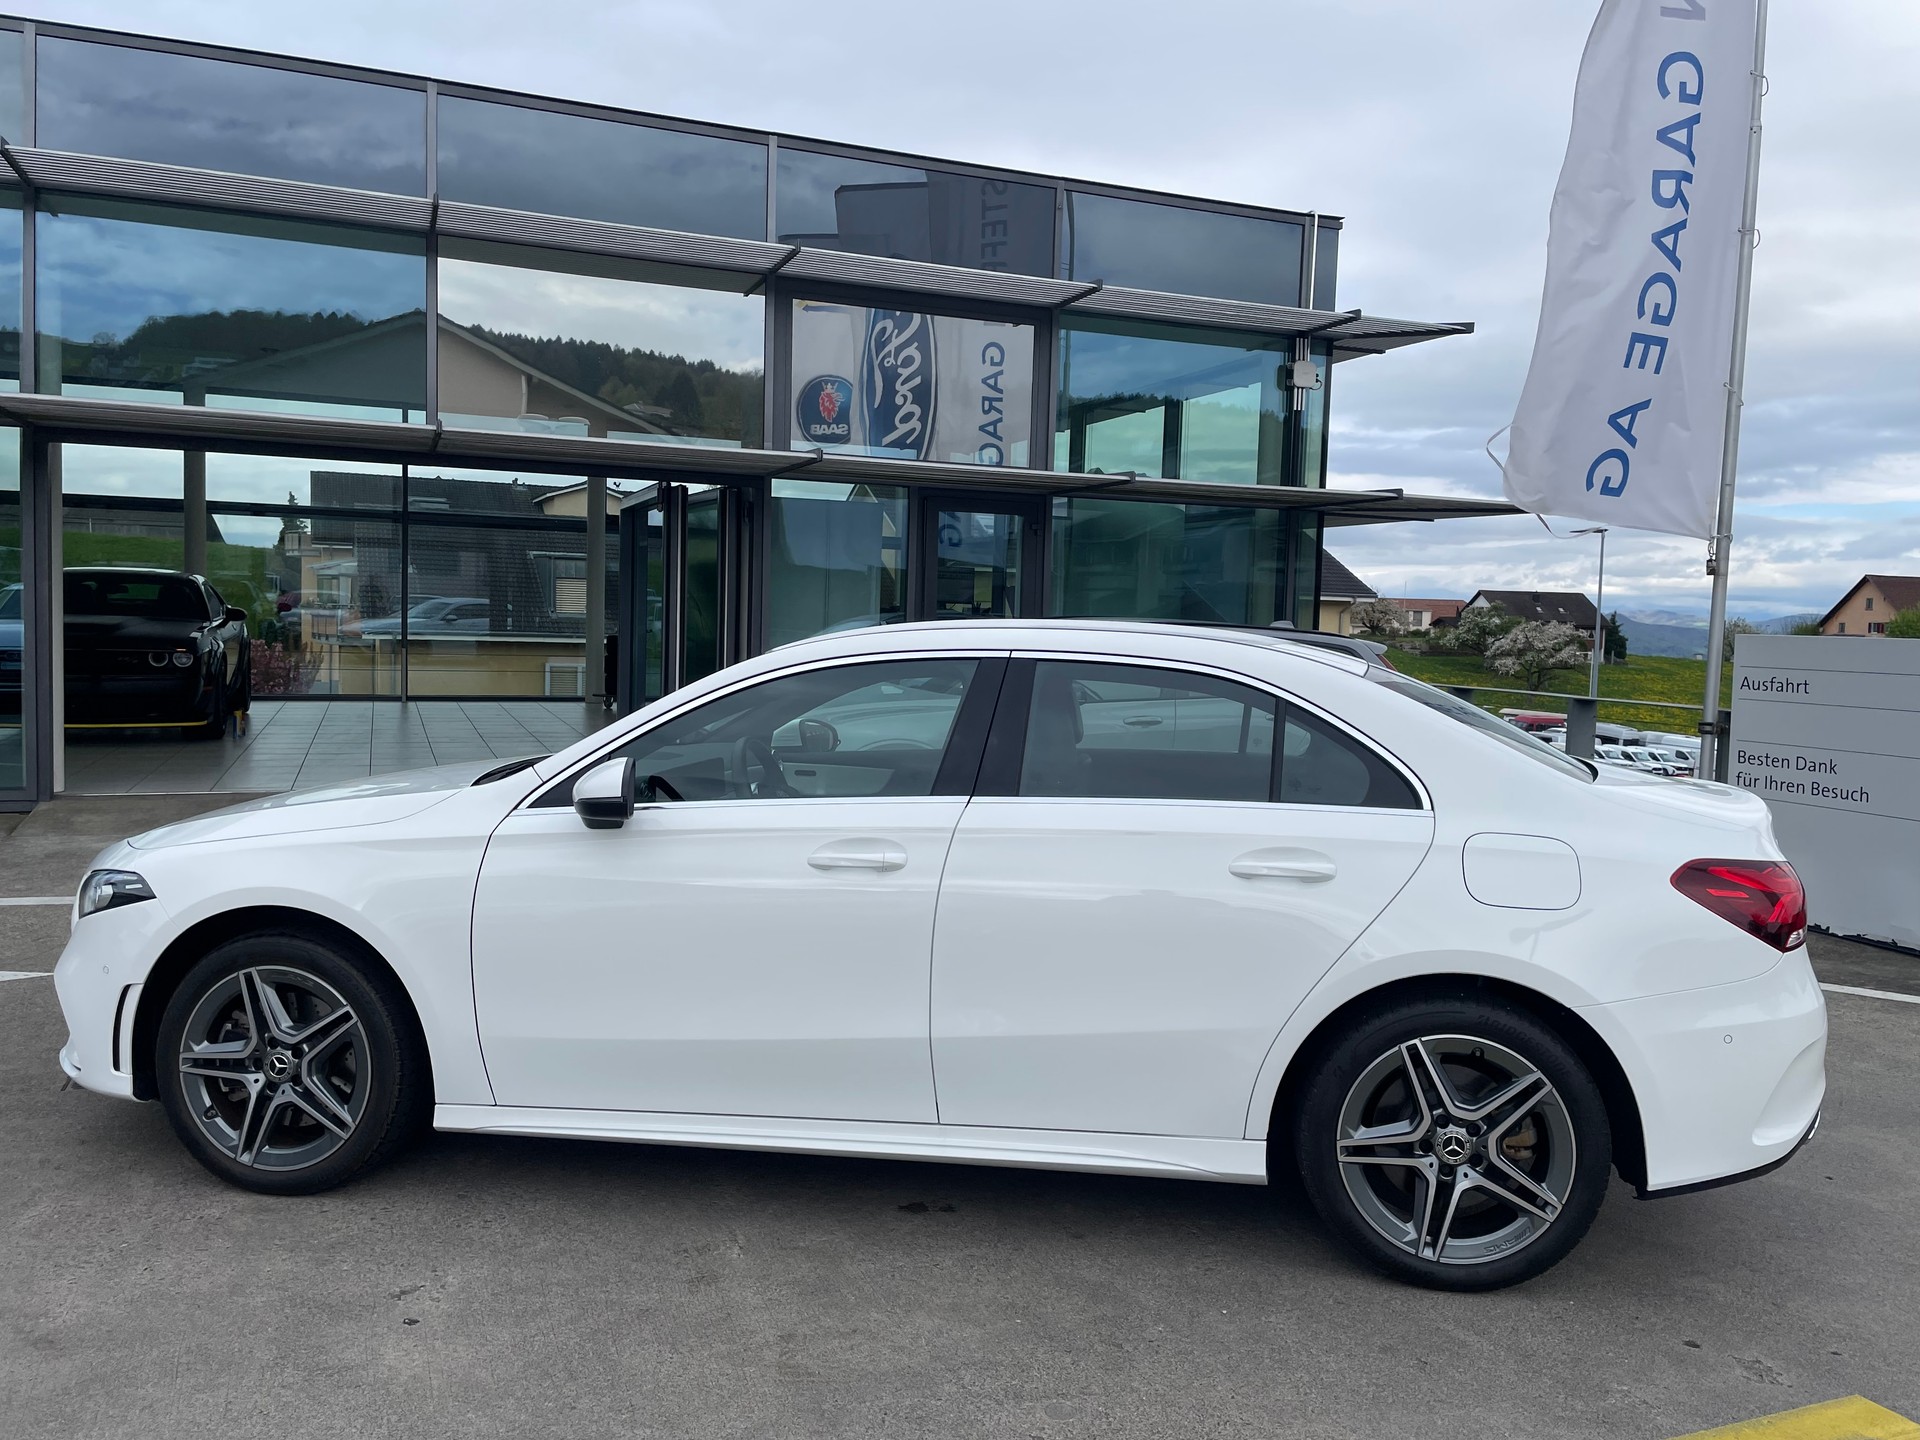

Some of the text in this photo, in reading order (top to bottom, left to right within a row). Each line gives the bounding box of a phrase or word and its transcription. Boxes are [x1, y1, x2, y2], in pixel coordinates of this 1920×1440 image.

[1740, 676, 1810, 695] Ausfahrt
[1737, 750, 1838, 775] Besten Dank
[1735, 771, 1870, 803] für Ihren Besuch
